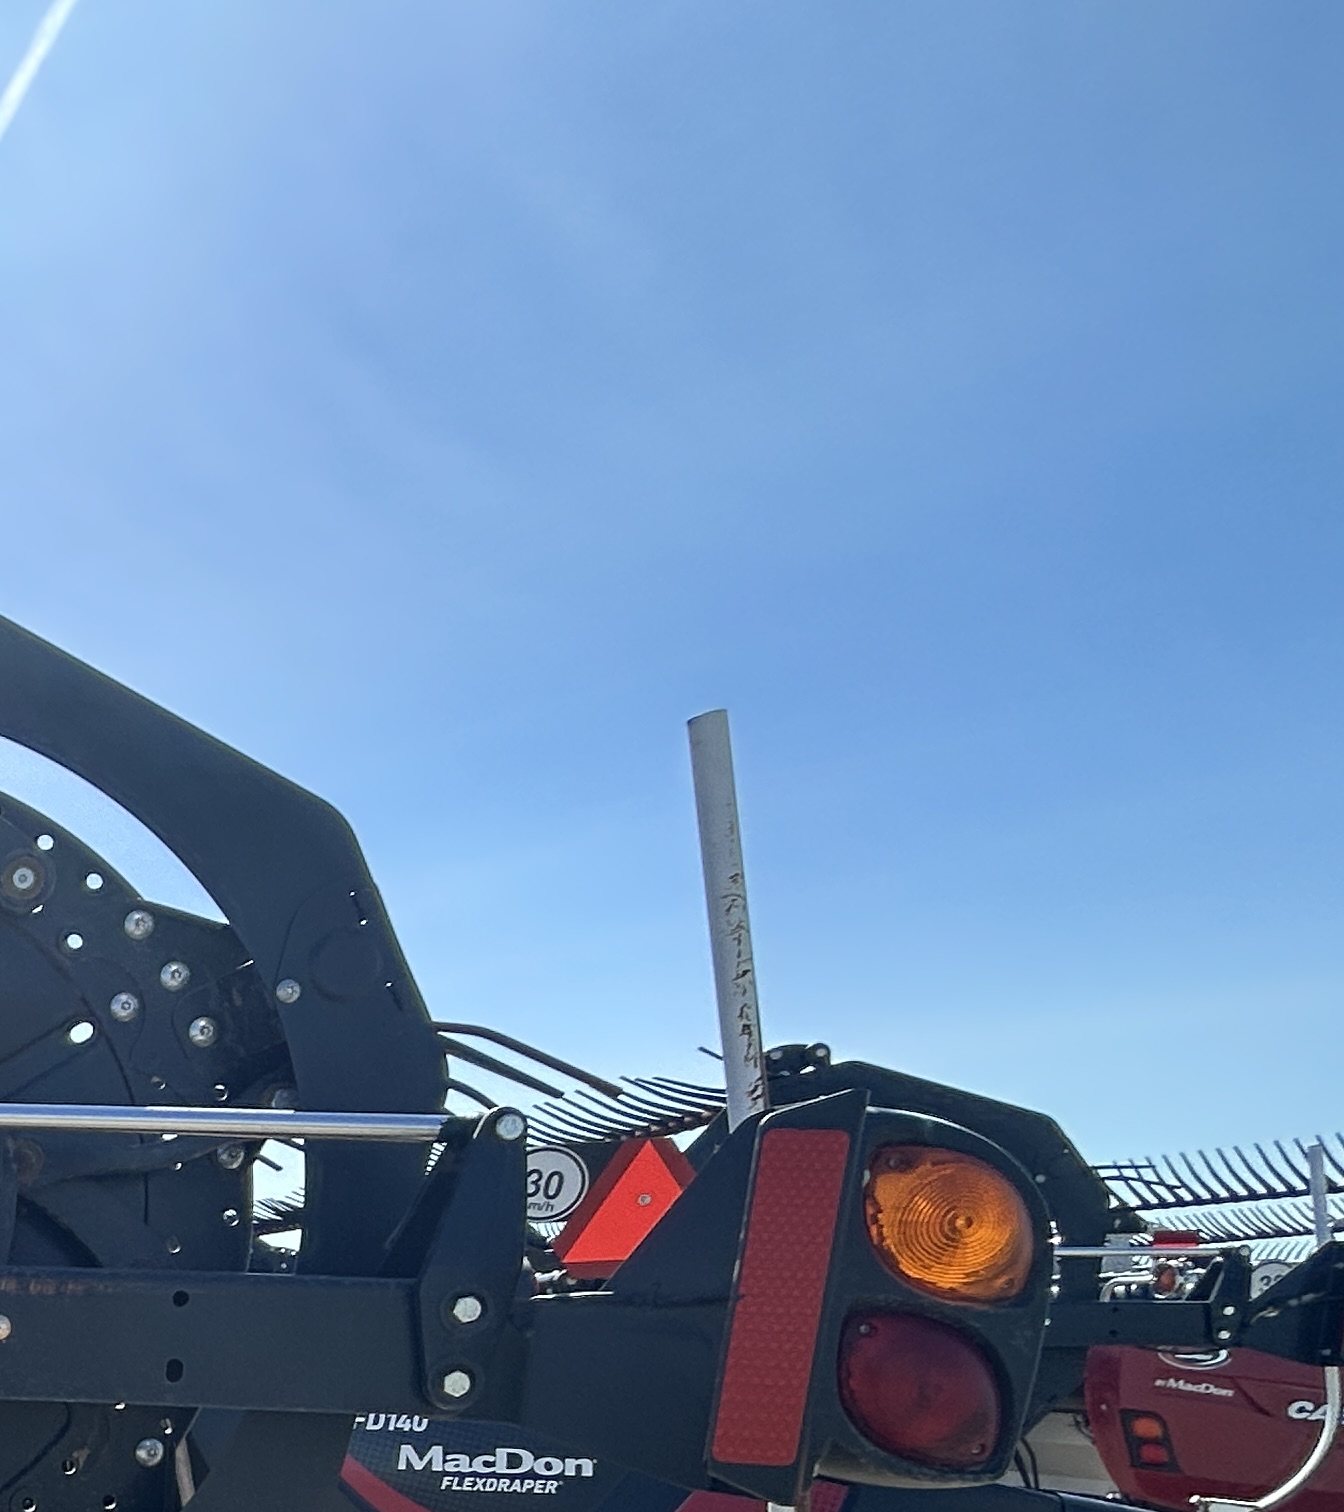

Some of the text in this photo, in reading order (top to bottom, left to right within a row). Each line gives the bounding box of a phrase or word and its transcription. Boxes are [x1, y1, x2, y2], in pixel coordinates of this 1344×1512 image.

[527, 1168, 564, 1200] 30
[527, 1201, 554, 1212] m/h
[397, 1444, 595, 1477] MacDon
[440, 1476, 559, 1494] FLEXDRAPER
